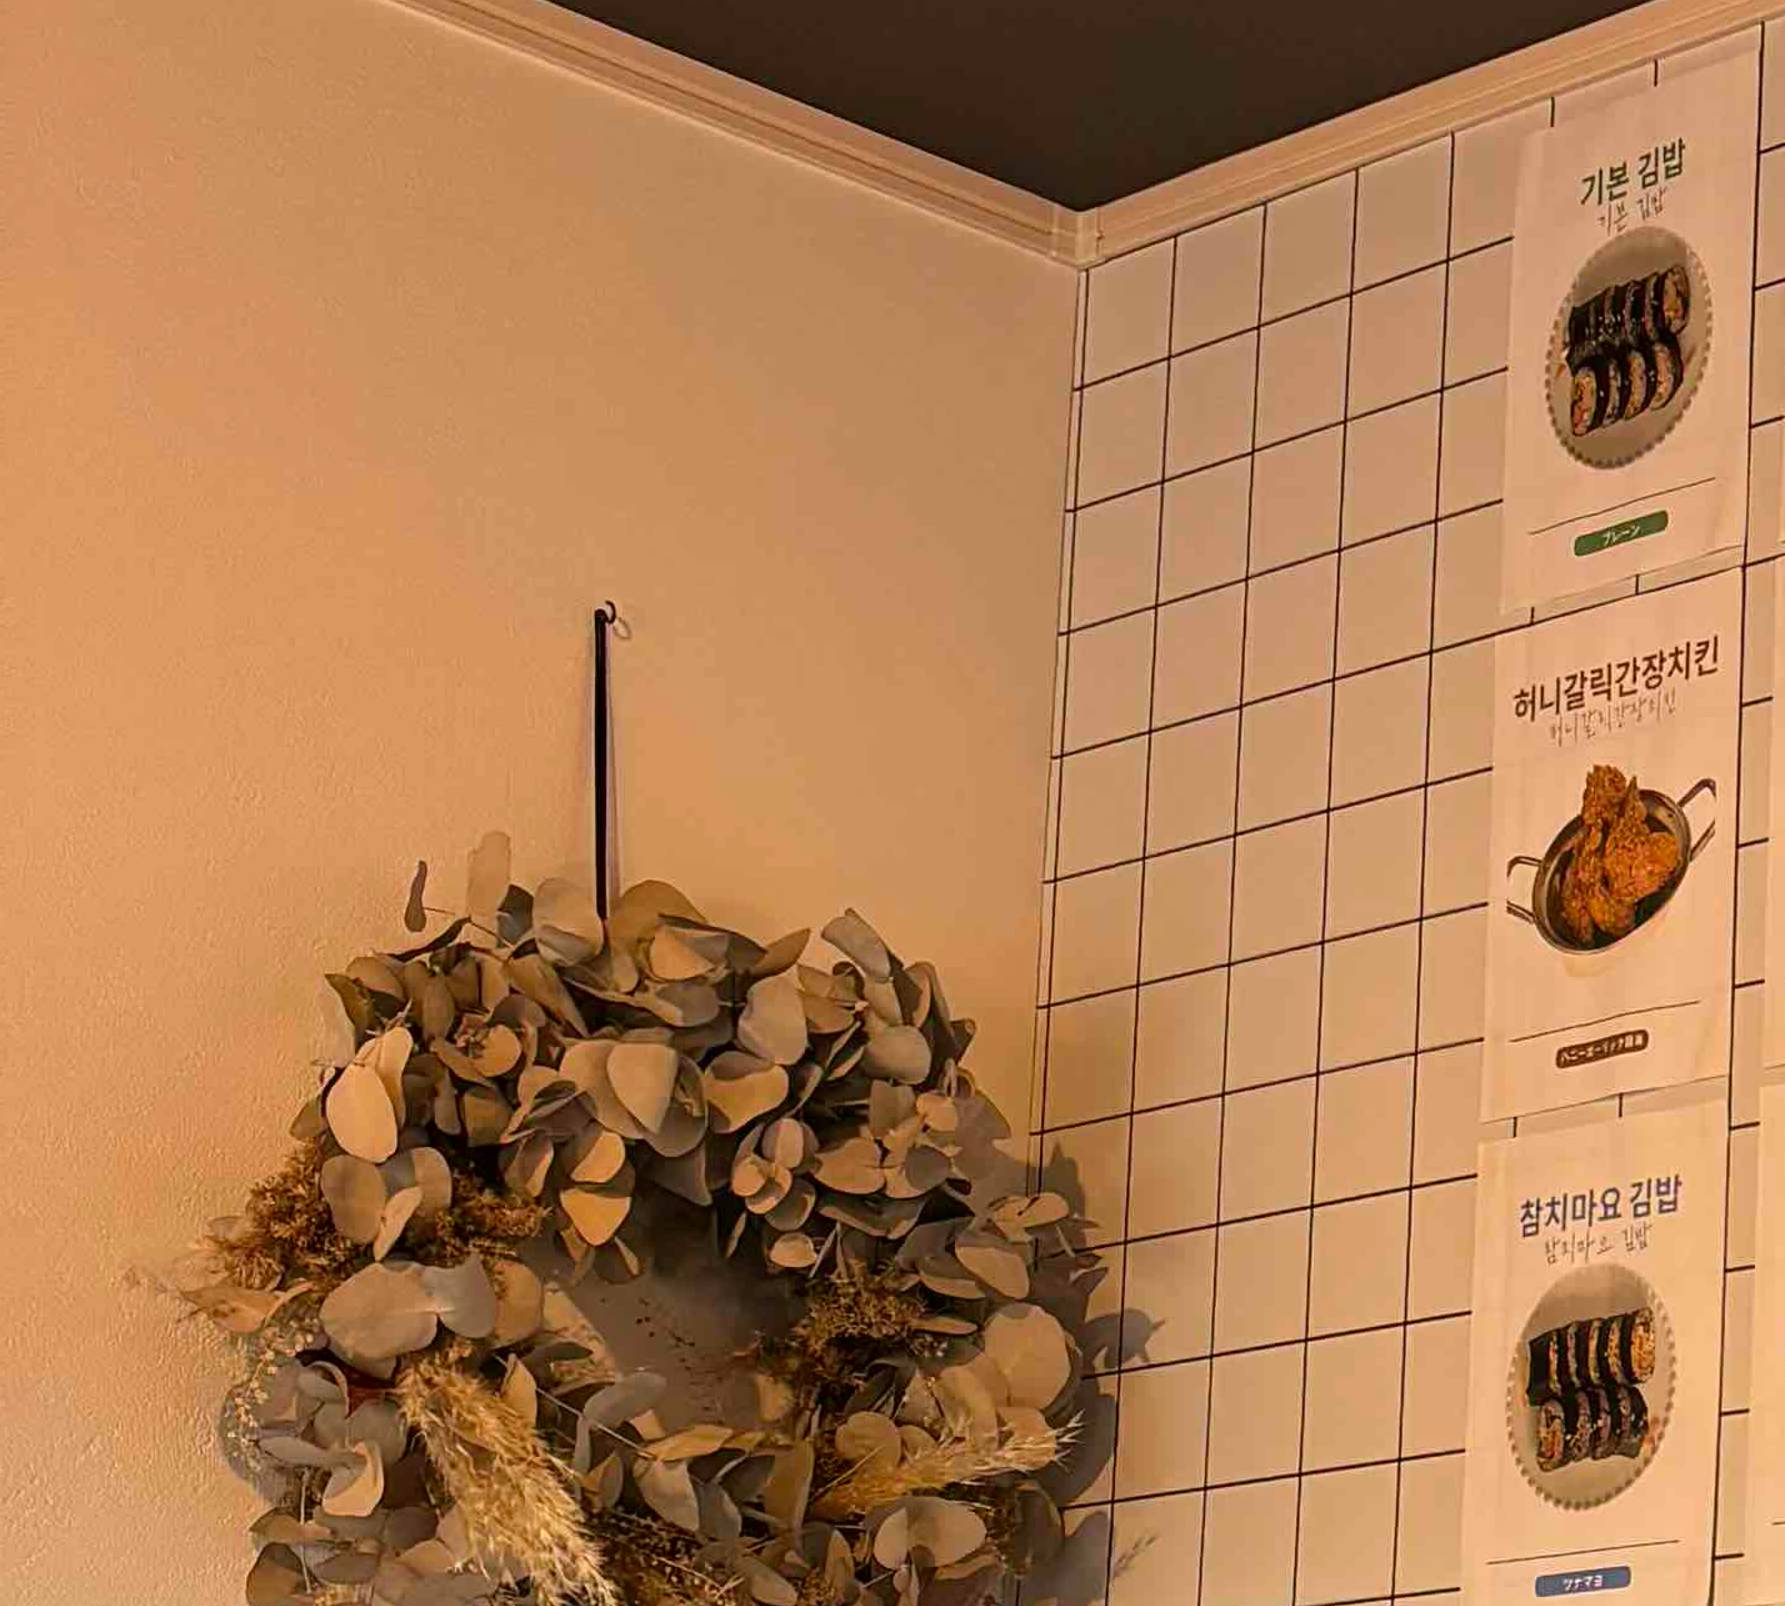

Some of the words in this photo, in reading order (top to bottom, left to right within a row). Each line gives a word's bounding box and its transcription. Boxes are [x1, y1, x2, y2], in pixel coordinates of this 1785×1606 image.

[1580, 160, 1629, 207] 기본
[1637, 139, 1685, 186] 김밥
[1513, 635, 1719, 722] 허니갈릭간장치킨
[1519, 1186, 1622, 1238] 참치마요
[1629, 1174, 1682, 1218] 김밥
[1562, 1574, 1604, 1591] ツナマヨ
